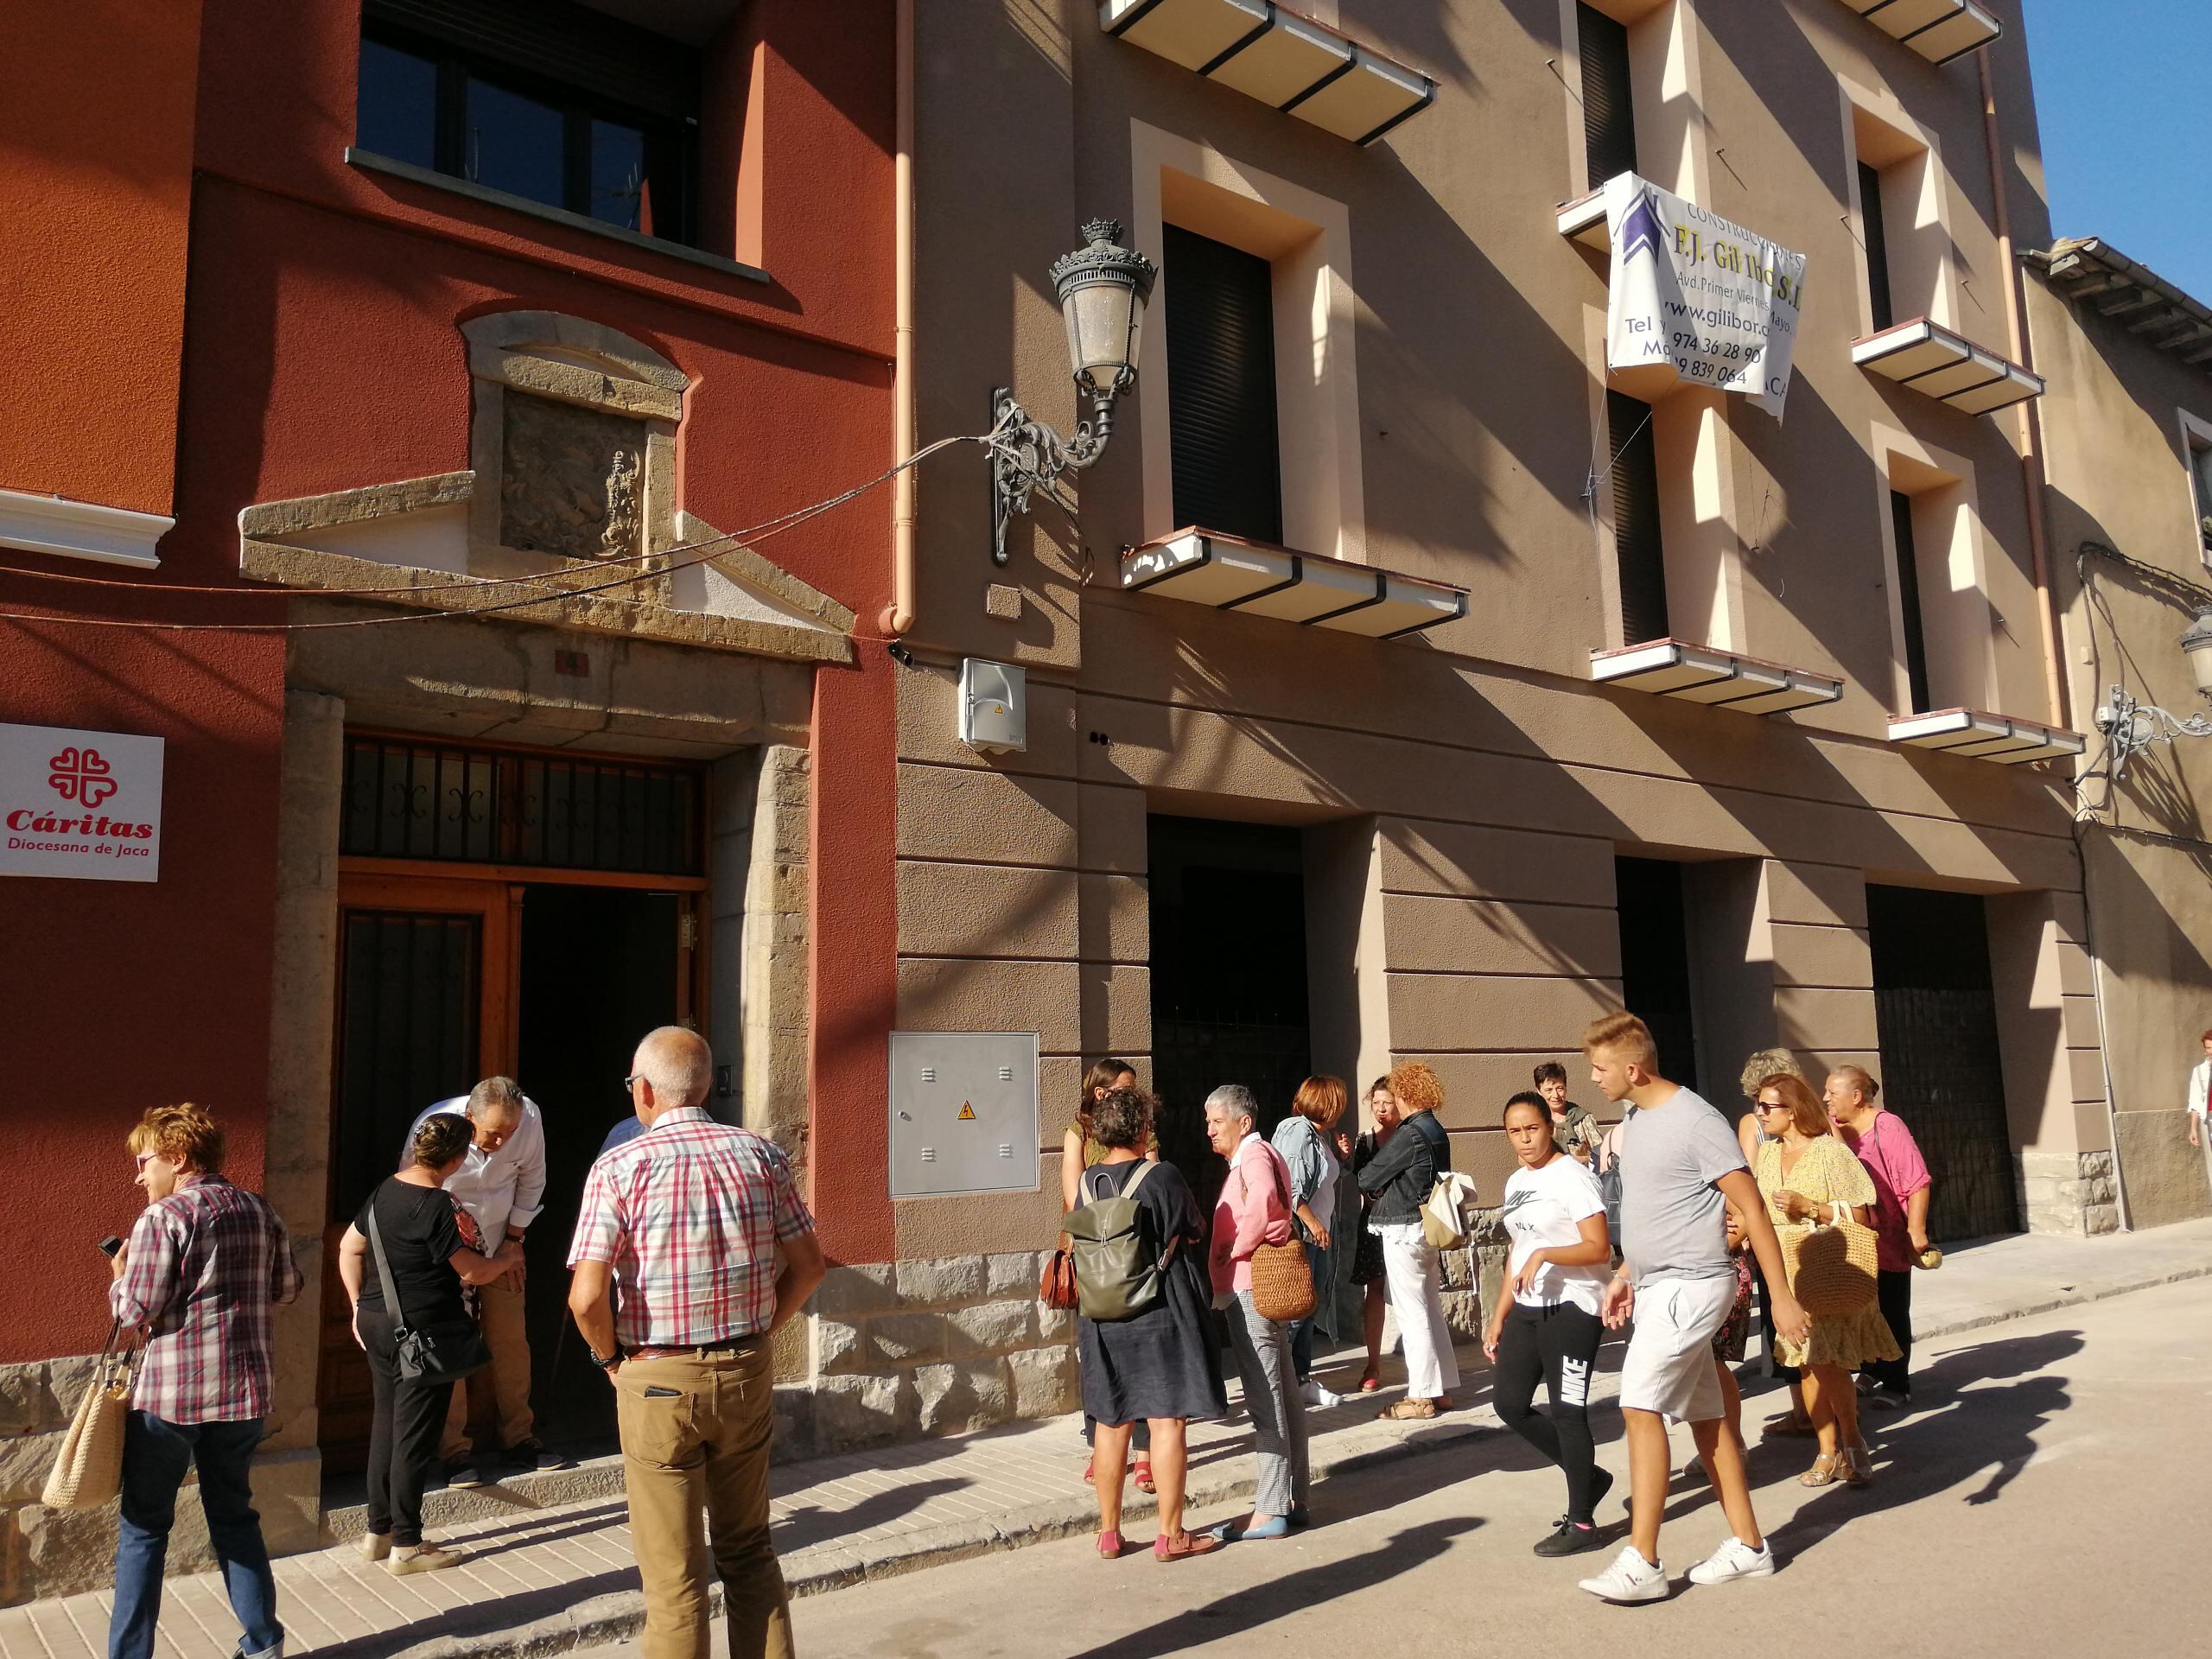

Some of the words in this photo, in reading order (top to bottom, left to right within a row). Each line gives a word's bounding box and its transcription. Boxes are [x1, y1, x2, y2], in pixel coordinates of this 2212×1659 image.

[1674, 226, 1705, 267] F.J.
[1713, 241, 1740, 274] Gil
[1737, 287, 1770, 311] Viernes
[1625, 316, 1652, 334] Tel
[1673, 332, 1698, 351] 974
[1703, 338, 1719, 354] 36
[1723, 342, 1740, 359] 28
[1745, 347, 1760, 363] 90
[1692, 360, 1714, 378] 839
[1718, 366, 1747, 384] 064
[6, 809, 153, 839] Cáritas
[8, 837, 90, 853] Diocesana
[94, 842, 112, 855] de
[116, 844, 149, 858] Jaca
[1560, 1355, 1588, 1407] NIKE
